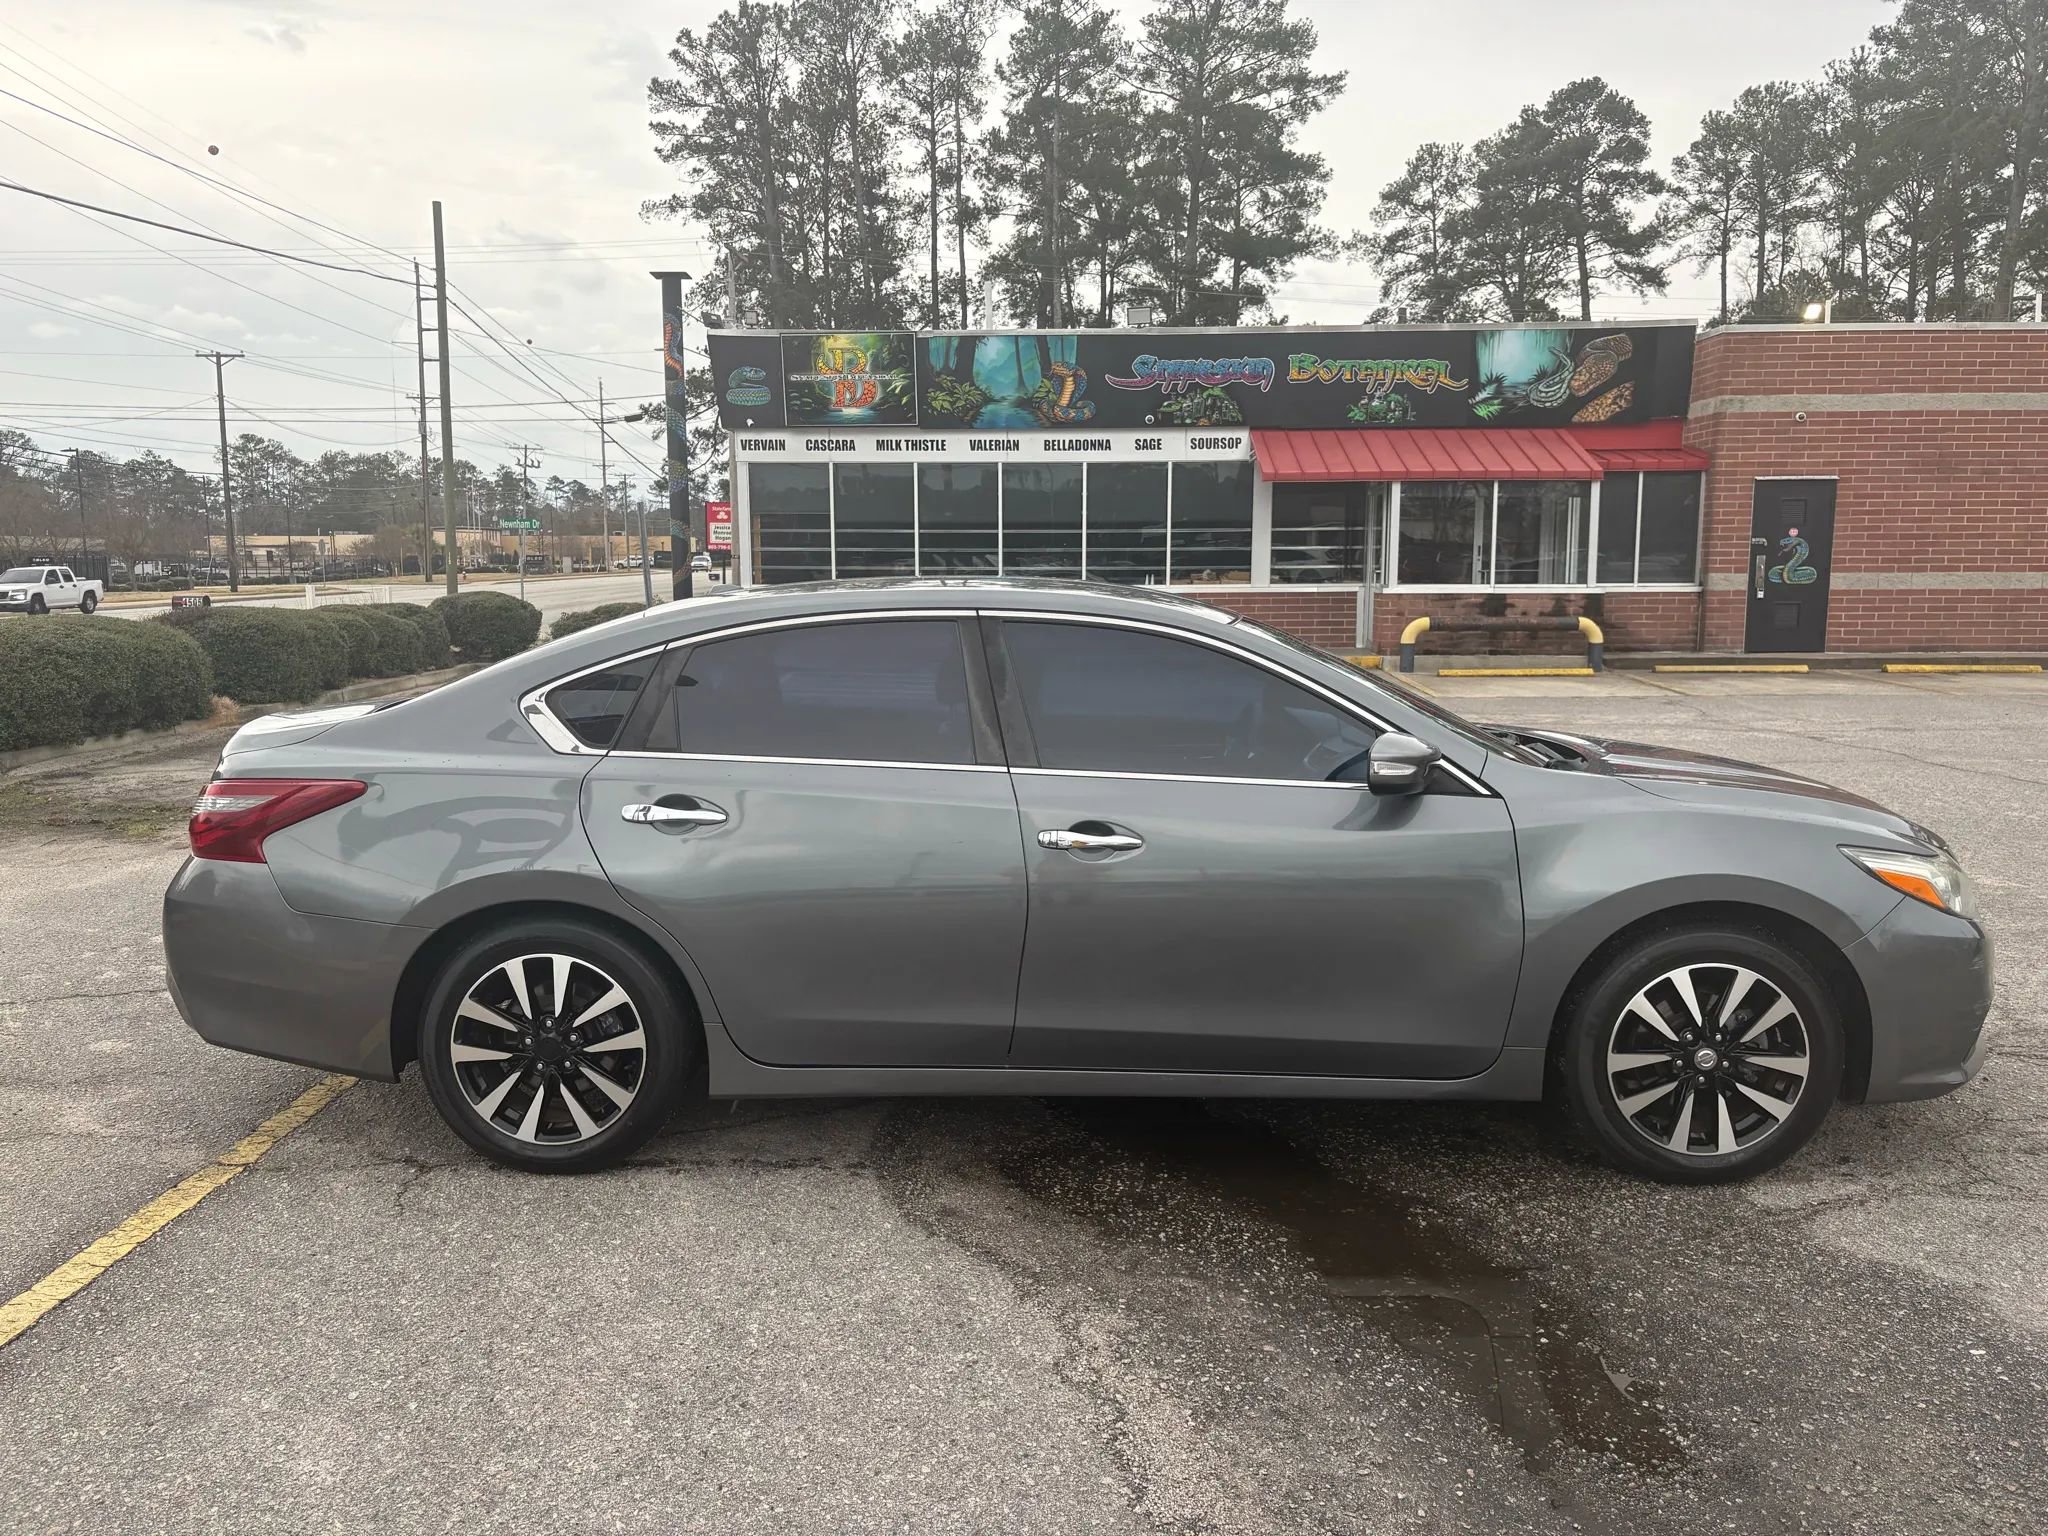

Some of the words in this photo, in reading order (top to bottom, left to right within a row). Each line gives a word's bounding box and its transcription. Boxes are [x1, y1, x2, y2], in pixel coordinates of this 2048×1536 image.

[740, 439, 786, 451] VERVAIN
[805, 439, 856, 451] CASCARA
[876, 439, 902, 451] MILK
[904, 439, 946, 451] THISTLE
[969, 439, 1020, 451] VALERIAN
[1044, 439, 1112, 451] BELLADONNA
[1134, 438, 1162, 450] SAGE
[1190, 437, 1242, 449] SOURSOP
[500, 519, 531, 529] Newnham
[532, 519, 540, 529] Dr
